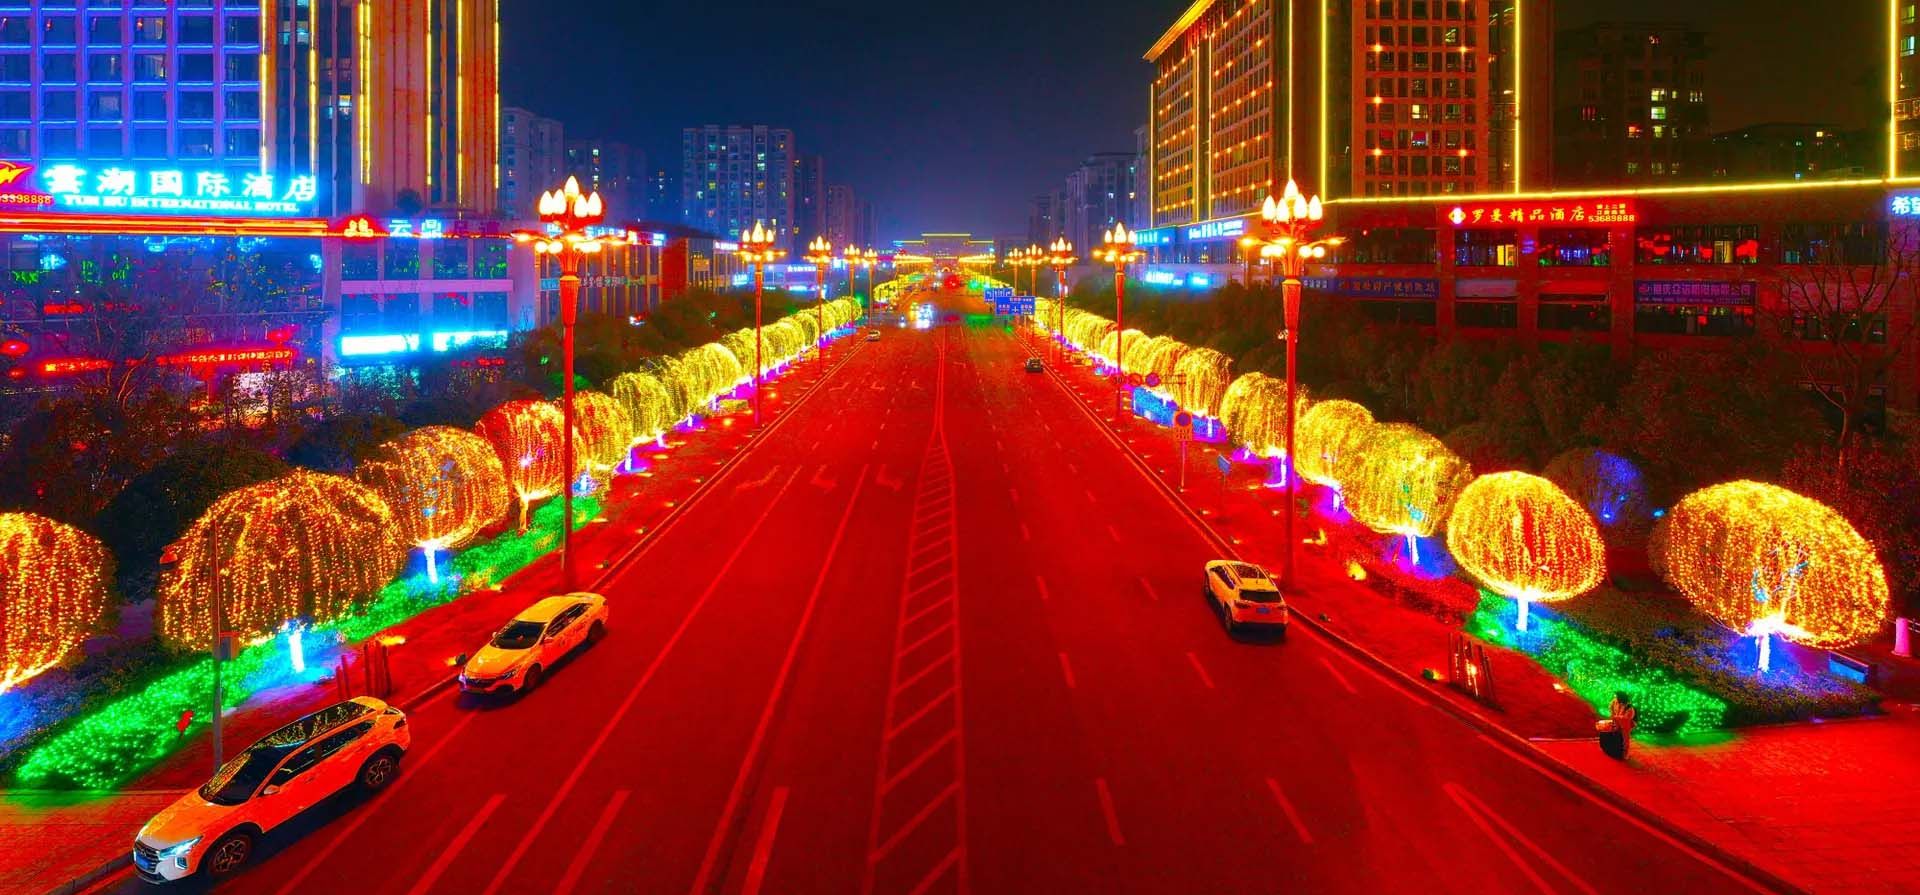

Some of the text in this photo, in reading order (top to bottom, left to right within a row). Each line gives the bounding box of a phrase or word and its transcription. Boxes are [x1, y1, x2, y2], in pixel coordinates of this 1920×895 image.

[130, 197, 252, 210] INTERNATIONAL
[255, 201, 300, 212] HOTEL
[1471, 206, 1585, 223] 罗曼精品酒店
[1588, 214, 1635, 222] 53689888
